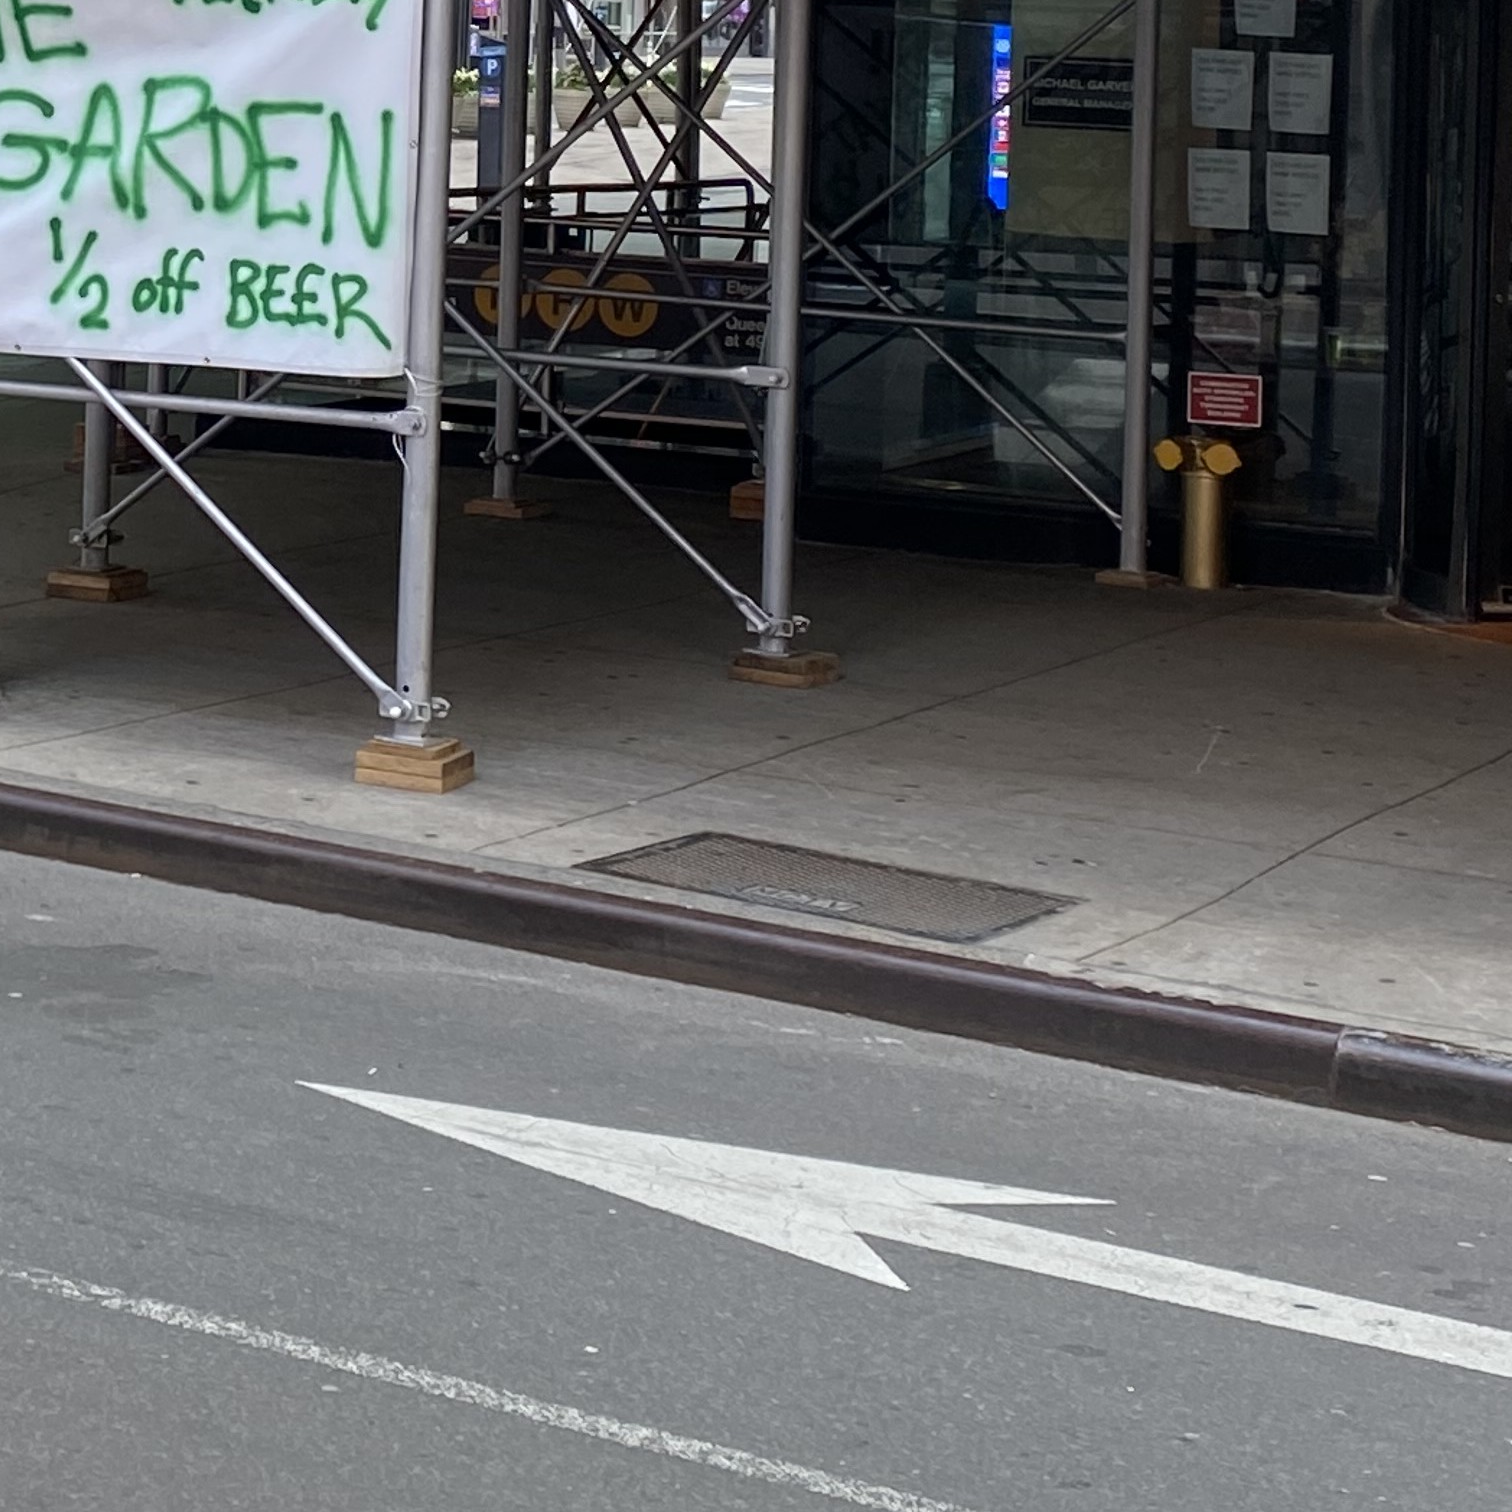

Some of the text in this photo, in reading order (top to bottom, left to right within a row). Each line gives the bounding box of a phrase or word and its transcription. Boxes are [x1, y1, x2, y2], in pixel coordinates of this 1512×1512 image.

[132, 248, 205, 314] off
[226, 258, 392, 350] BEER
[724, 333, 740, 348] at
